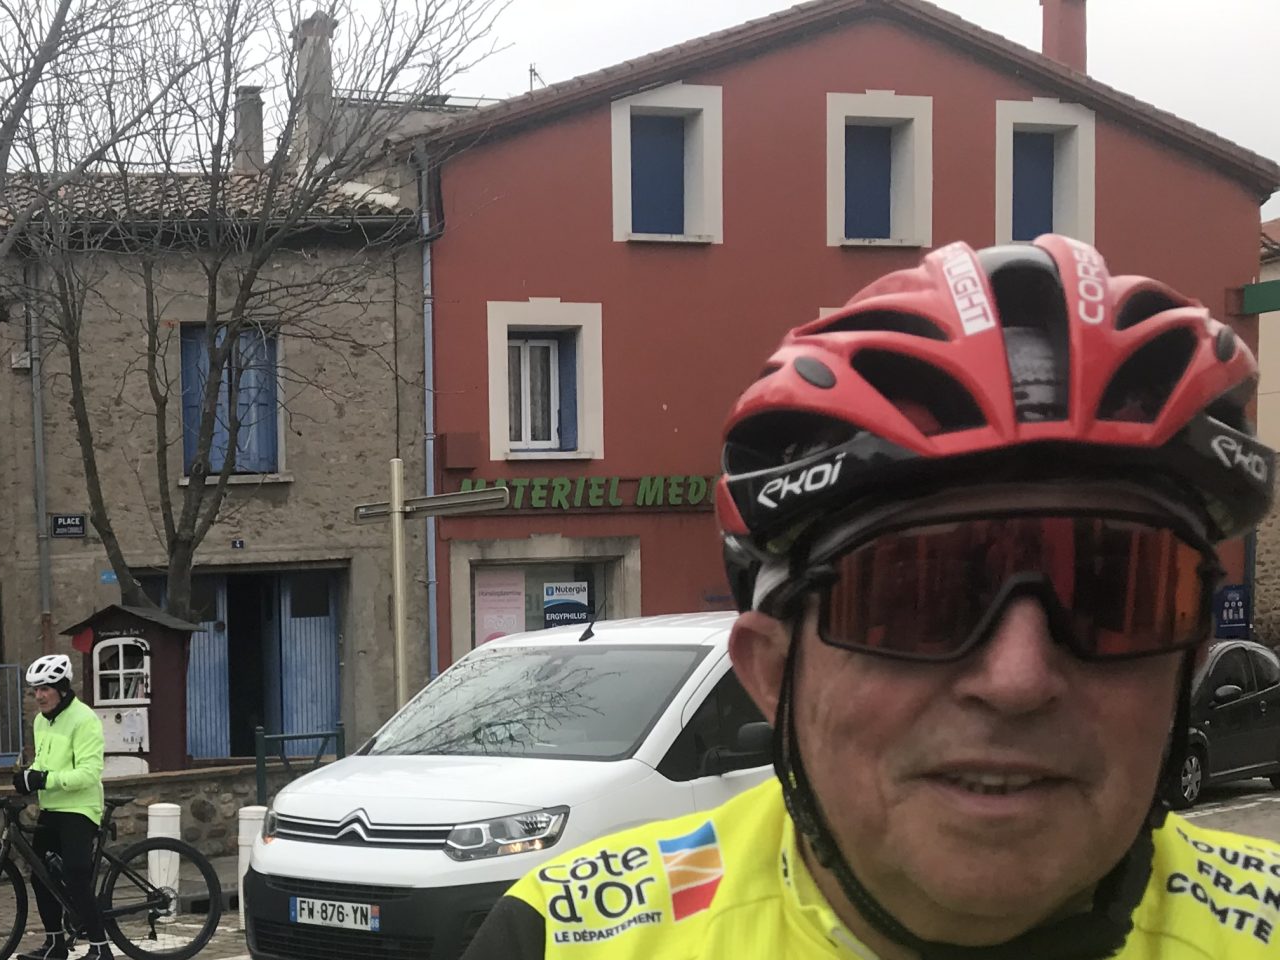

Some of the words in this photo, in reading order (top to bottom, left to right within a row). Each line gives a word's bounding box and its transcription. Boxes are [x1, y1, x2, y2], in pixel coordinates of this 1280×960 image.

[636, 475, 719, 506] MED
[58, 517, 81, 525] PLACE
[555, 585, 587, 594] Nutergia
[546, 612, 587, 621] ERGYPHILUS
[538, 846, 649, 884] Côte
[548, 876, 655, 923] d'Or
[1167, 872, 1272, 944] COMTE
[554, 930, 571, 943] LE
[573, 911, 662, 943] DÉPARTEMENT
